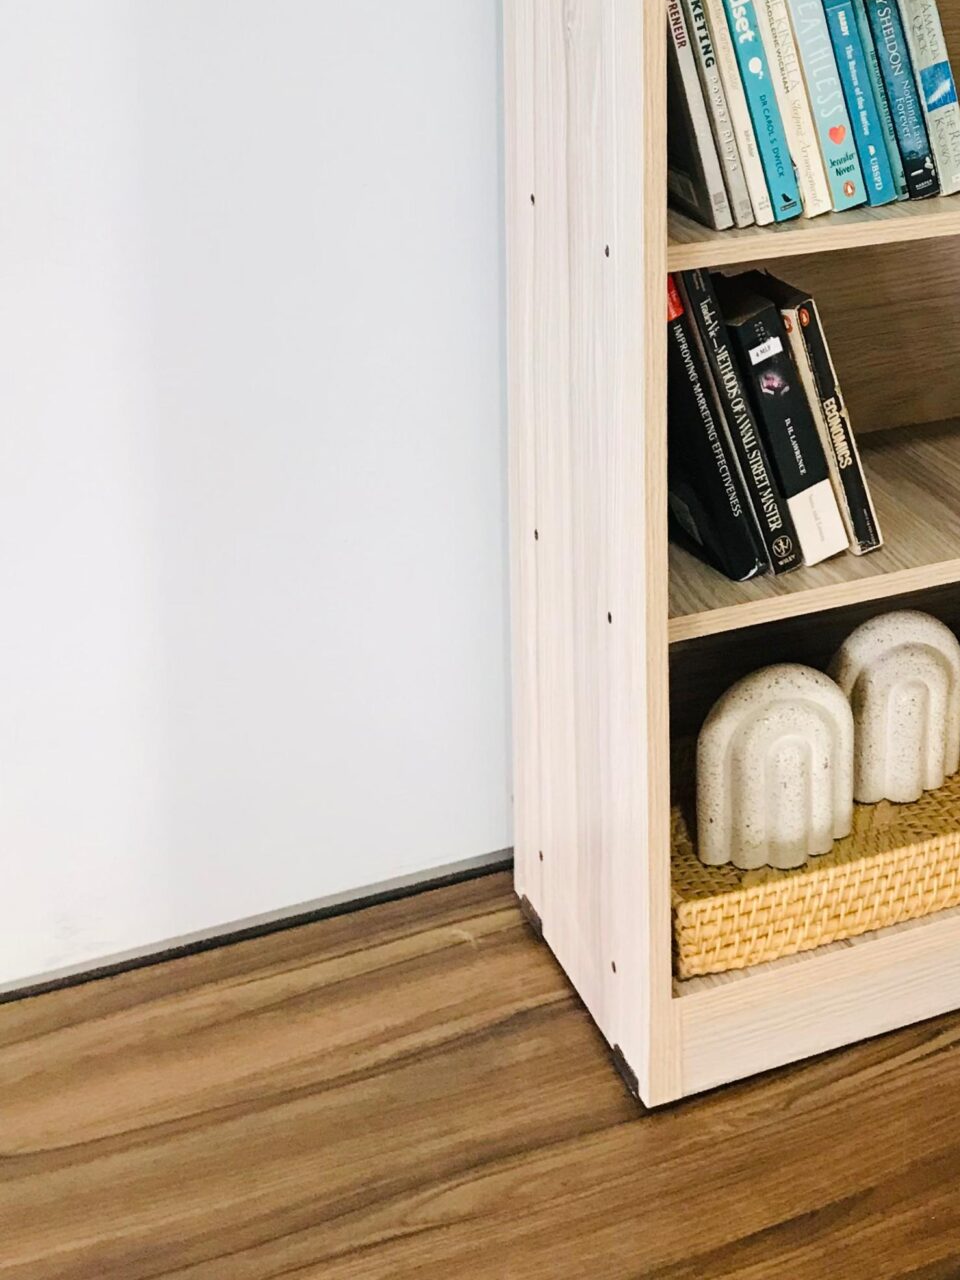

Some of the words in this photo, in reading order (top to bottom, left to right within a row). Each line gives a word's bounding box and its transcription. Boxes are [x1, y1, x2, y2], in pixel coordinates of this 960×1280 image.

[838, 10, 849, 37] HARDY
[912, 14, 928, 56] QUICK
[920, 3, 940, 61] AMANDA
[776, 17, 800, 90] KINSELLA
[845, 44, 854, 60] The
[877, 7, 904, 76] SHELDON
[776, 49, 790, 94] WICKHAM
[760, 94, 767, 108] DR
[855, 87, 863, 97] of
[857, 97, 865, 110] the
[763, 108, 775, 137] CAROL
[792, 98, 805, 137] Sleeping
[859, 110, 870, 136] Native
[896, 97, 911, 138] Forever
[902, 79, 917, 125] Nothing
[912, 124, 923, 149] Lasts
[944, 105, 956, 128] THE
[771, 147, 785, 178] DWECK
[829, 151, 855, 169] Jennifer
[835, 163, 855, 177] Niven
[673, 324, 698, 382] IMPROVING
[693, 383, 718, 441] MARKETING
[712, 441, 743, 518] EFFECTIVENESS
[823, 396, 853, 470] ECONOMICS
[730, 398, 746, 415] OF
[738, 419, 756, 455] WALL
[747, 449, 771, 491] STREET
[759, 487, 783, 533] MASTER
[790, 434, 807, 476] LAWRENCE
[778, 554, 796, 566] WILEY
